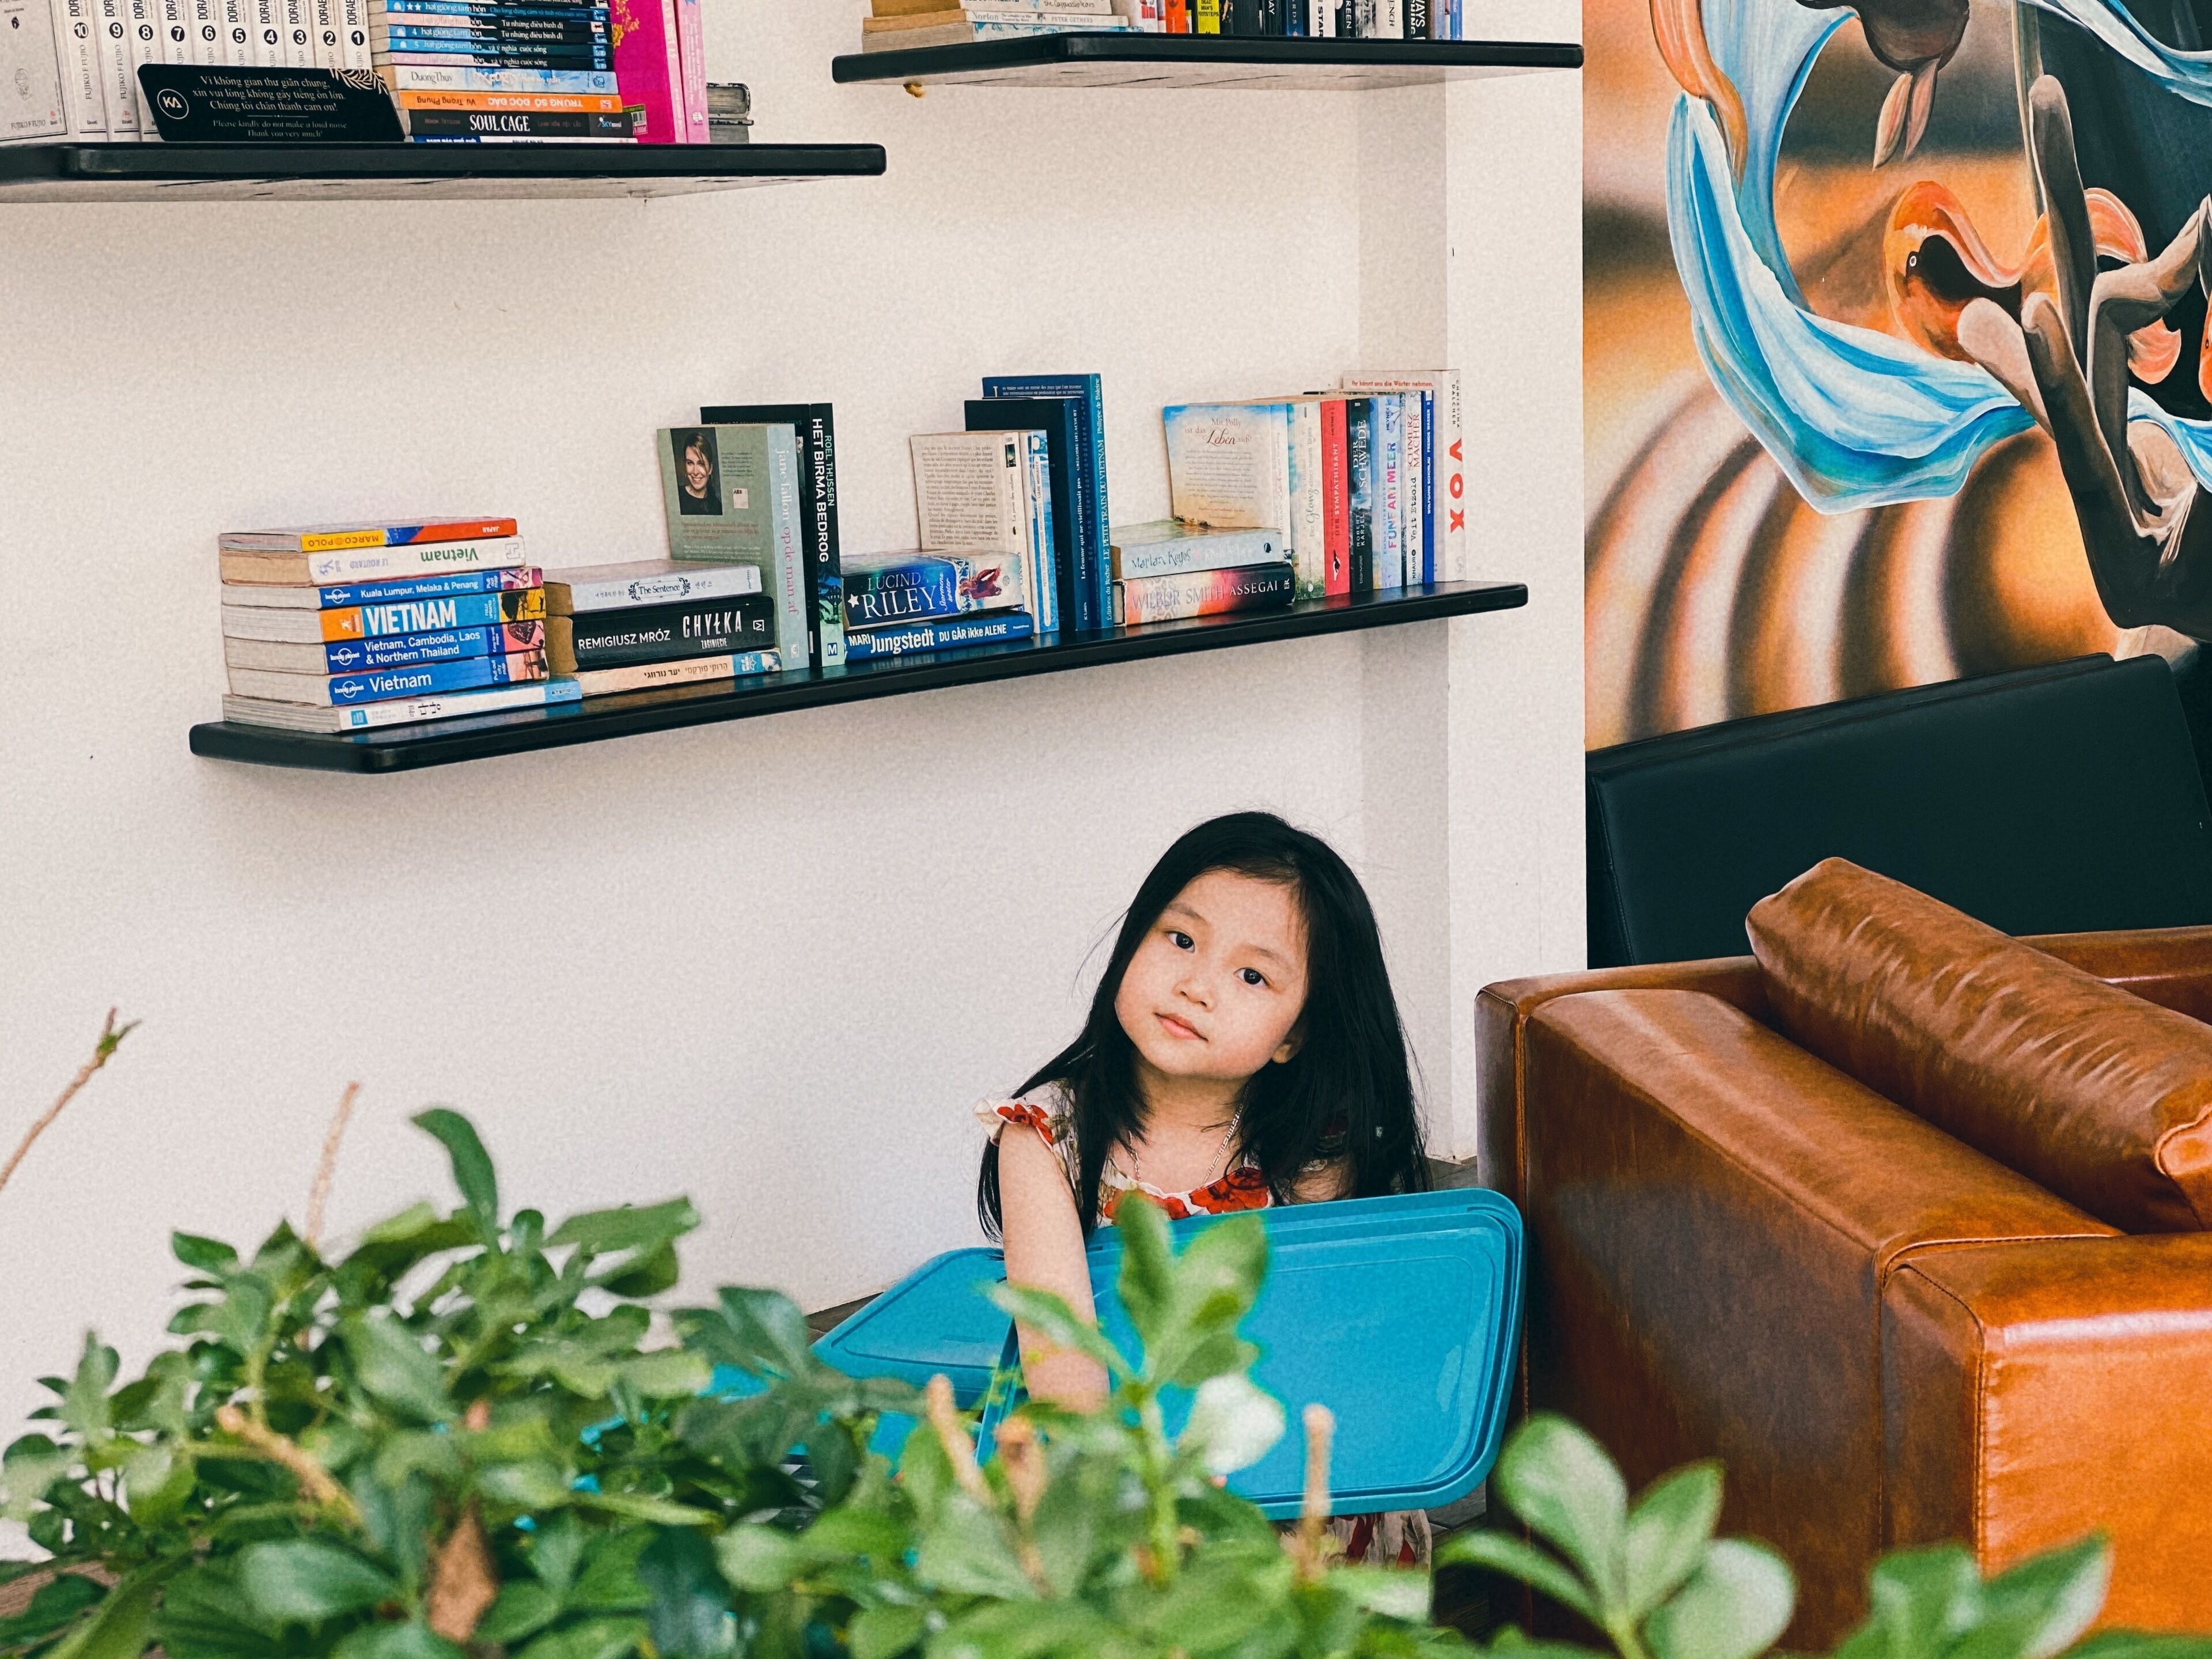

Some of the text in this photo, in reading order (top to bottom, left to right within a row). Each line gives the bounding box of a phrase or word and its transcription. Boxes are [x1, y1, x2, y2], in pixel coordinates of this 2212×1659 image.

[972, 12, 999, 21] Norton
[74, 23, 88, 38] 10
[112, 24, 121, 37] 9
[142, 26, 150, 39] 8
[174, 28, 181, 40] 7
[205, 27, 213, 40] 6
[235, 29, 243, 42] 5
[266, 31, 275, 43] 4
[296, 31, 304, 44] 3
[326, 33, 334, 44] 2
[354, 32, 360, 44] 1
[214, 75, 243, 87] không
[244, 77, 263, 88] gian
[209, 88, 224, 97] vui
[246, 89, 275, 100] không
[238, 120, 259, 128] kindly
[469, 115, 500, 131] SOUL
[500, 115, 531, 132] CAGE
[1203, 427, 1236, 447] Leben
[1357, 420, 1368, 488] SCHWEDE
[1387, 442, 1396, 483] MEER
[775, 448, 793, 521] jane fallon
[1332, 442, 1340, 515] SYMPATHISANT
[1449, 437, 1464, 533] VOX
[812, 418, 829, 563] HET BIRMA BEDROG
[308, 535, 379, 547] MARCO POLO
[781, 527, 791, 541] op
[420, 548, 479, 562] Vietnam
[784, 546, 795, 562] de
[1131, 553, 1166, 570] Marian
[1168, 548, 1191, 567] Keyes
[350, 558, 380, 569] ROUTARD
[361, 589, 382, 599] Kuala
[384, 586, 414, 599] Lumpur,
[416, 584, 442, 593] Melaka
[452, 580, 479, 592] Penang
[639, 583, 680, 594] The Sentence
[785, 566, 795, 596] man
[861, 585, 937, 619] RILEY
[1132, 580, 1278, 609] WILBUR SMITH ASSEGAI
[366, 599, 457, 636] VIETNAM
[683, 610, 743, 638] CHYŁKA
[365, 631, 480, 652] Vietnam, Cambodia, Laos
[578, 629, 671, 650] REMIGIUSZ MRÓZ
[848, 628, 935, 654] MARI Jungstedt
[939, 631, 950, 642] DU
[951, 628, 967, 641] GÅR
[968, 627, 983, 638] ikke
[984, 624, 1007, 636] ALENE
[366, 645, 460, 664] & Northern Thailand
[369, 673, 432, 693] Vietnam
